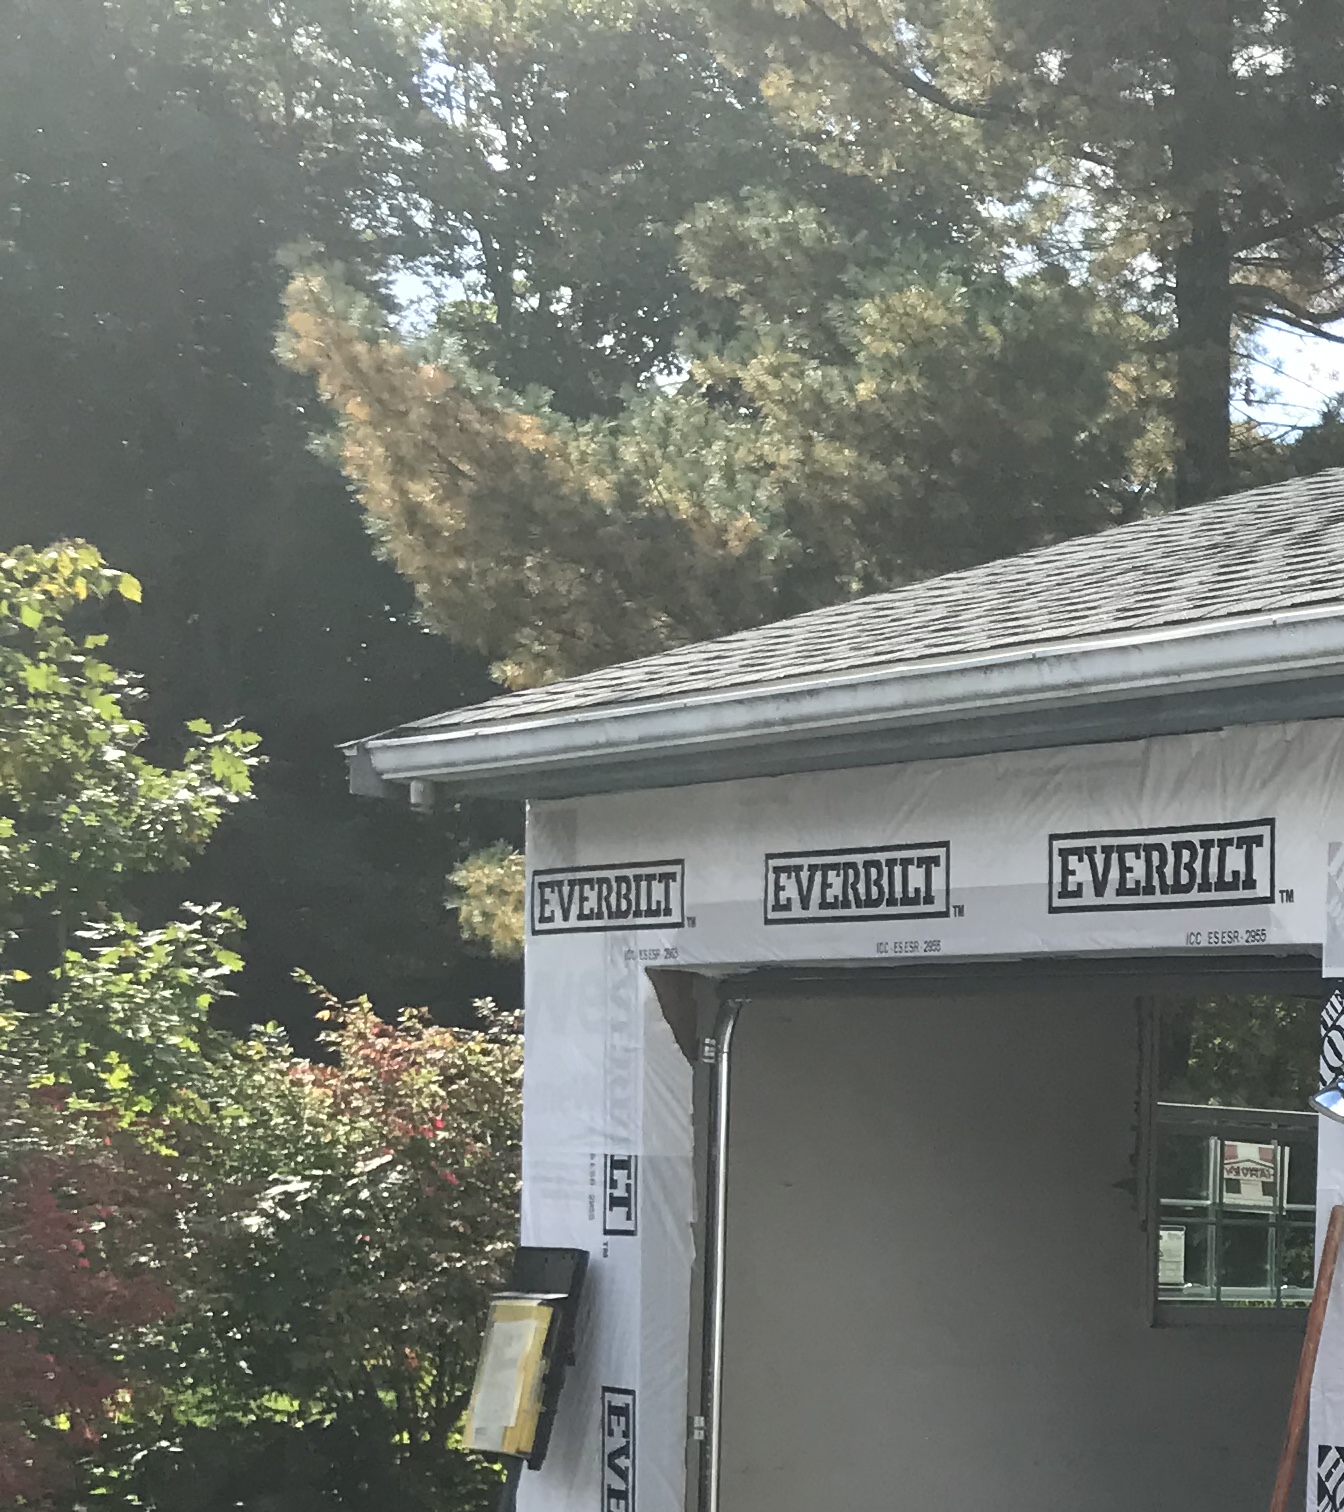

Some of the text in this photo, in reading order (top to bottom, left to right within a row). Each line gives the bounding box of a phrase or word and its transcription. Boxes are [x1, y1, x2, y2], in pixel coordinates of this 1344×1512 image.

[770, 855, 940, 913] EVERBILT
[1057, 834, 1264, 899] EVERBILT
[538, 871, 677, 924] EVERBILT
